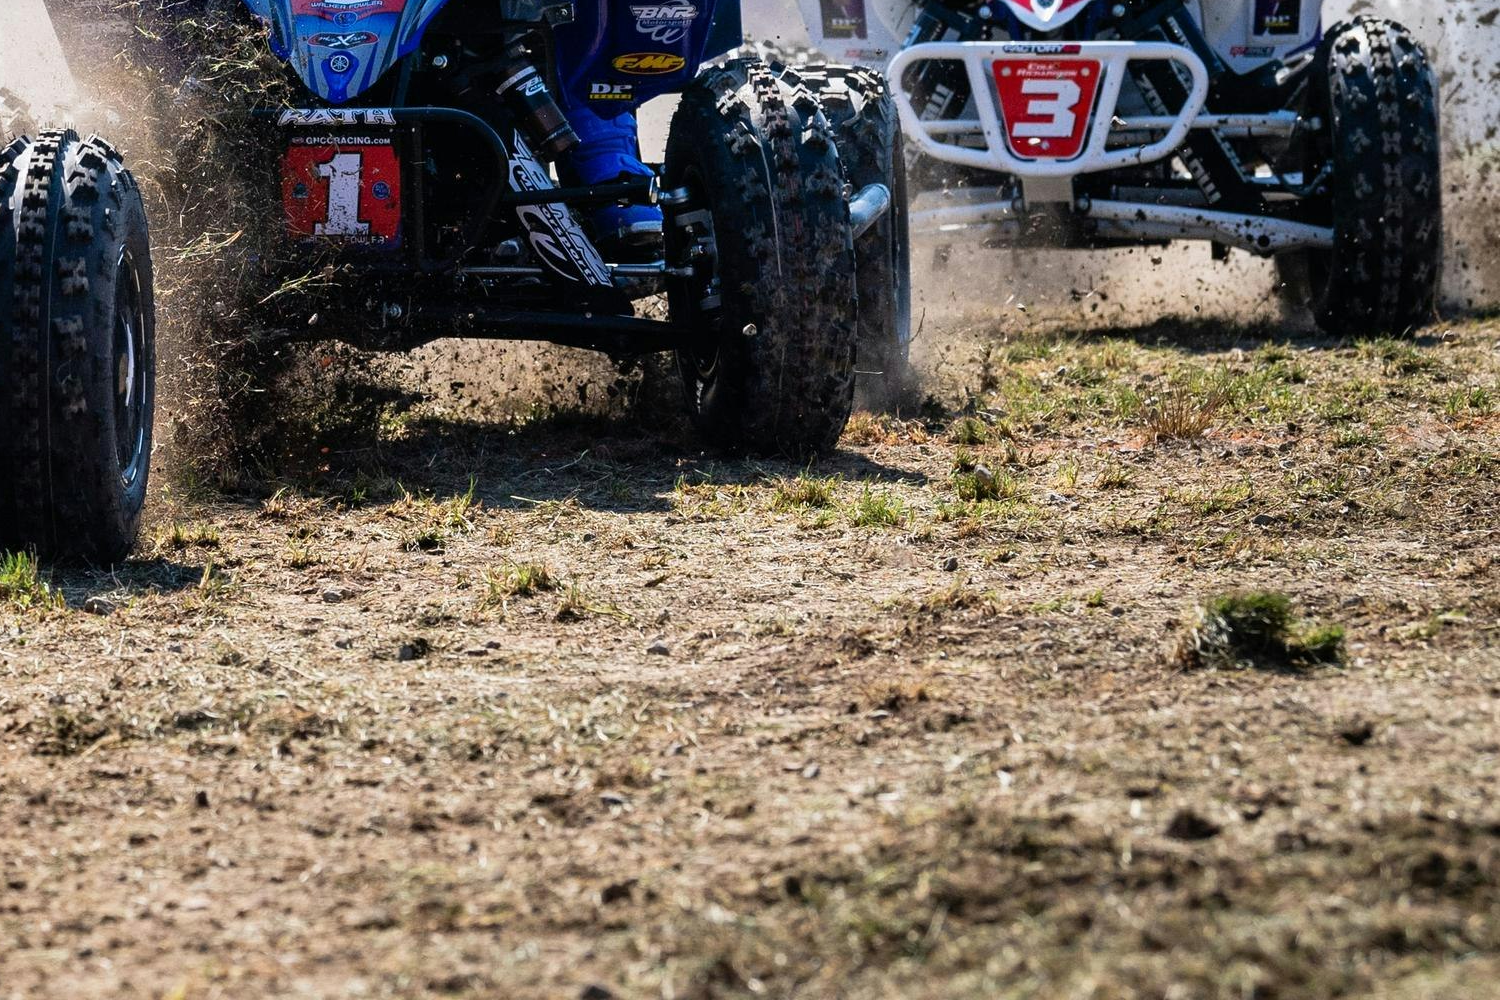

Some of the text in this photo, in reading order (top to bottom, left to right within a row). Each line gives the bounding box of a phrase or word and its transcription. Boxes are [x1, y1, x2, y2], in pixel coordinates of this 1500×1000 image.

[591, 83, 633, 94] DP
[1012, 79, 1082, 138] 3
[314, 153, 370, 236] 1
